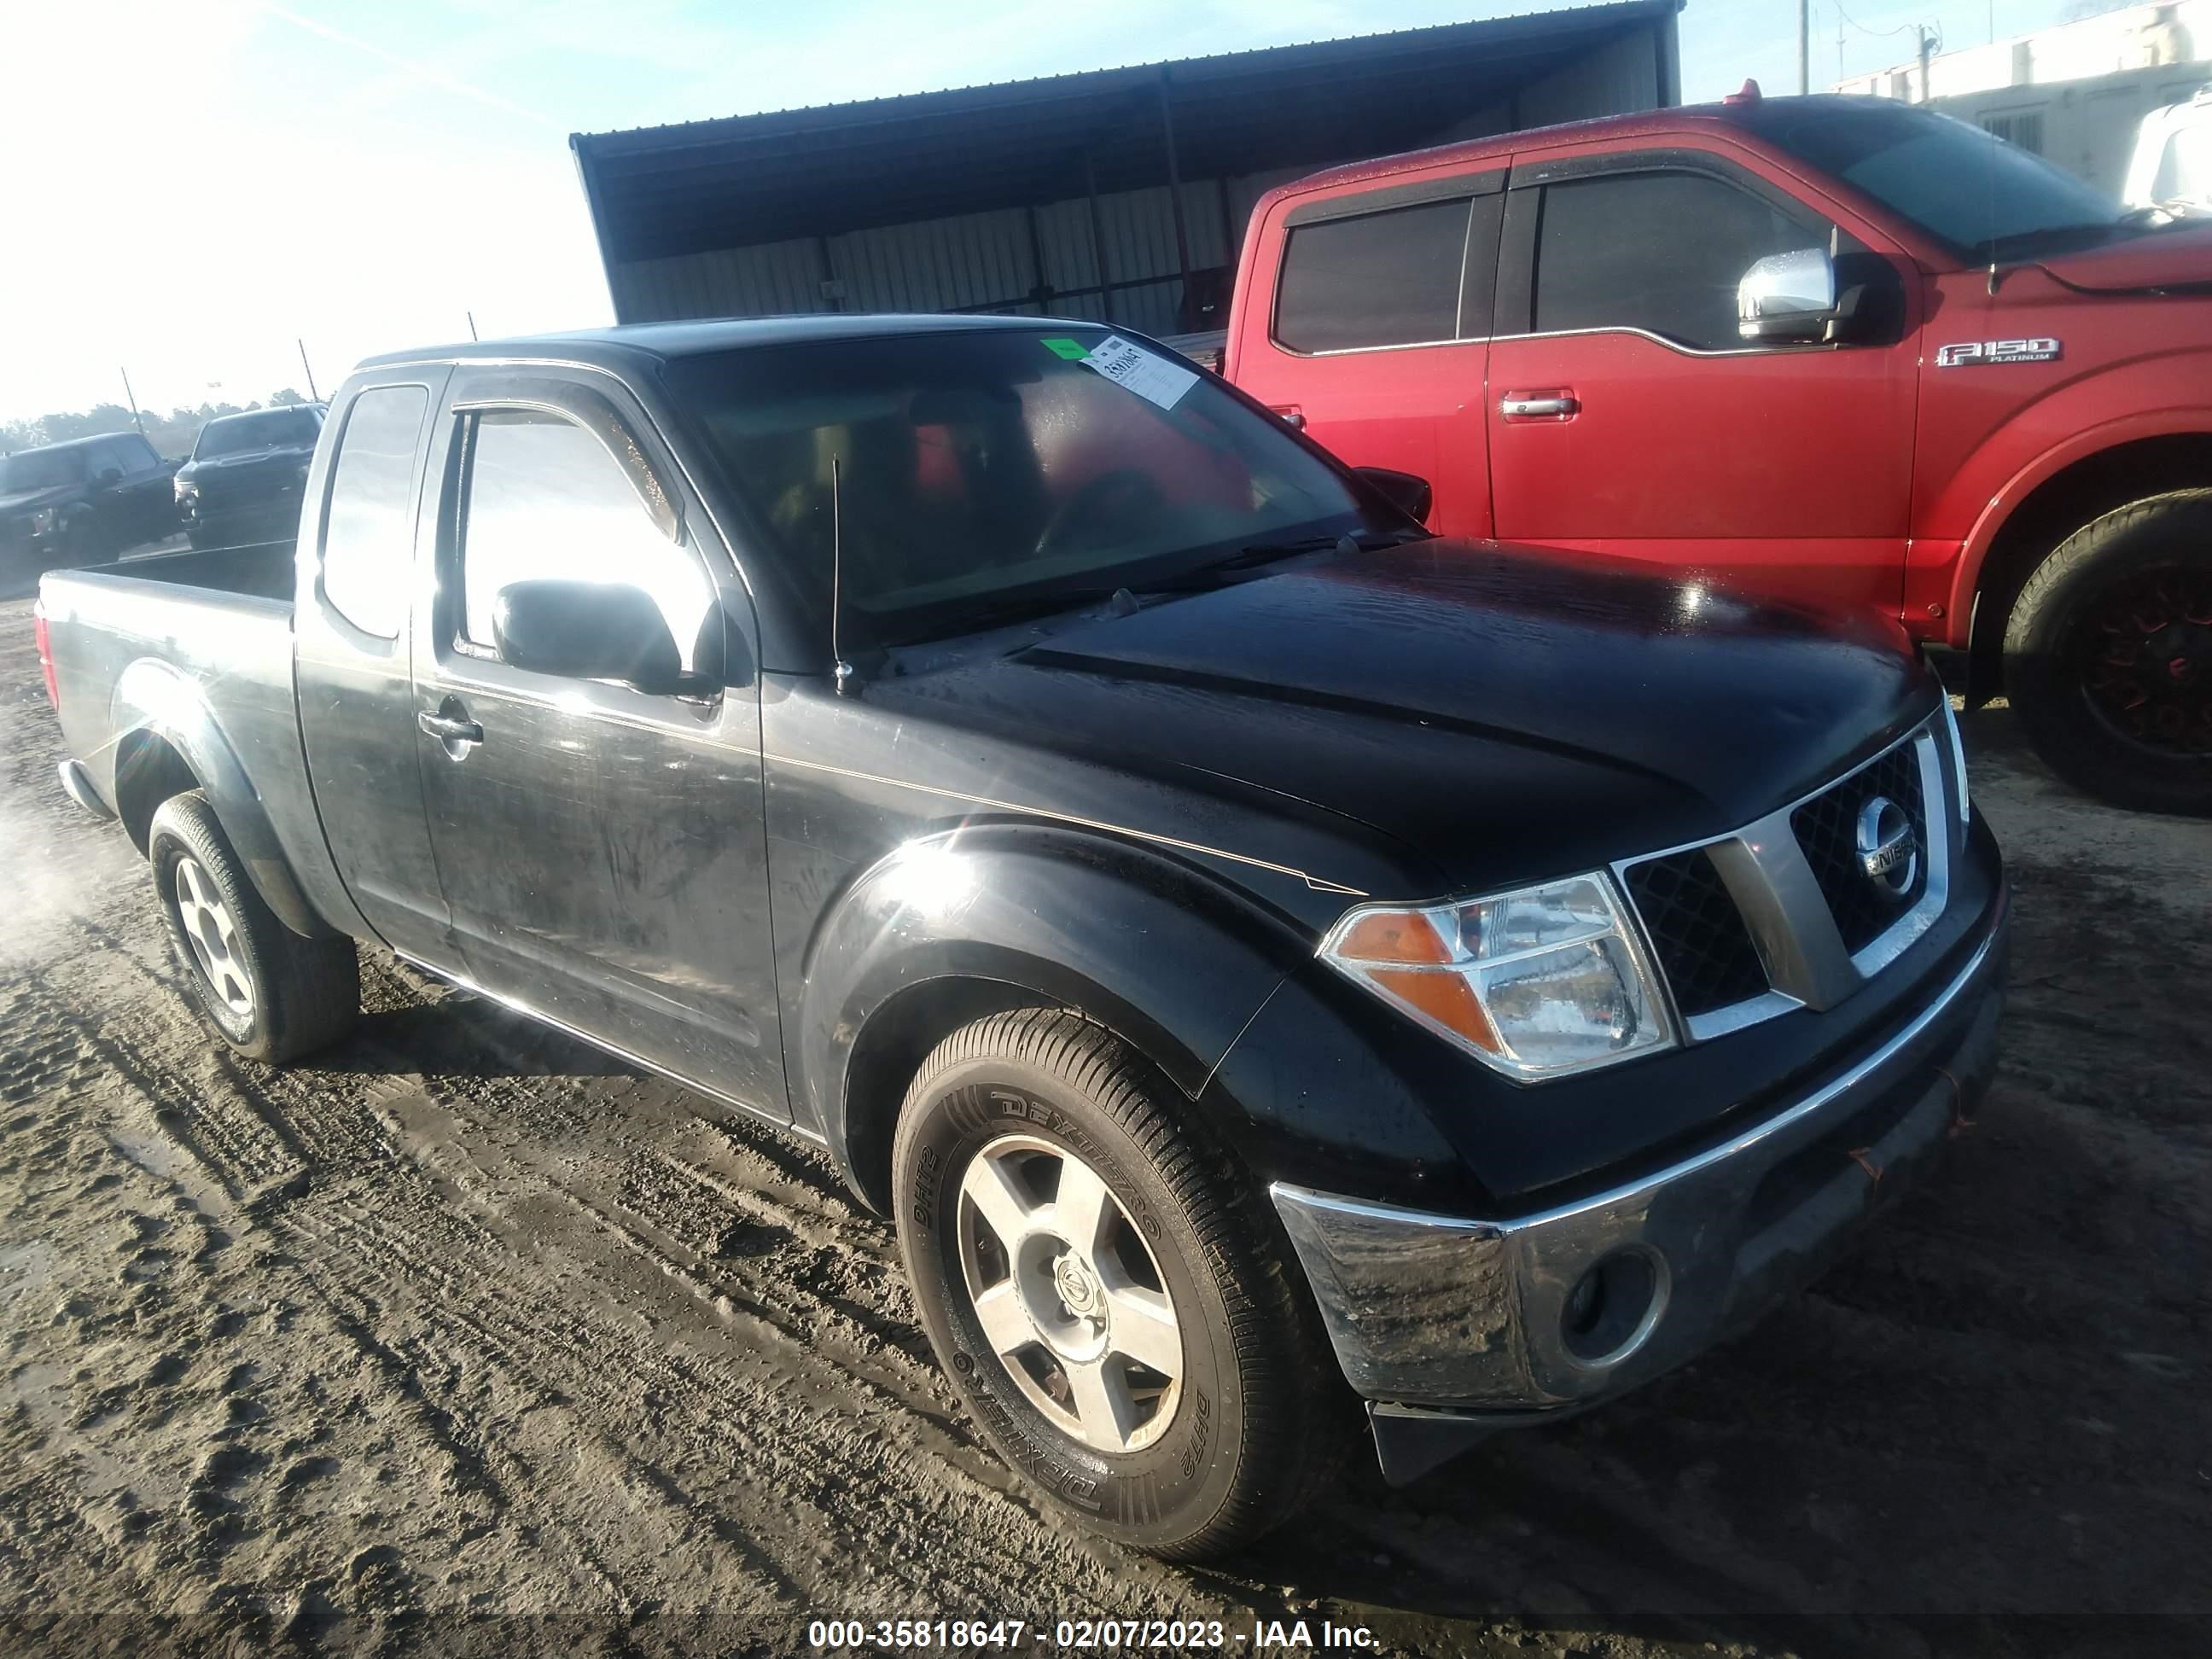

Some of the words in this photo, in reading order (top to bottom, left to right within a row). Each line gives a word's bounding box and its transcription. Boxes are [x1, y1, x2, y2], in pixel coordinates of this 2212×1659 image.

[1990, 353, 2050, 363] PLATINUM
[915, 1144, 938, 1230] DHT2
[952, 1352, 1102, 1511] DEXTERO
[1183, 1388, 1210, 1481] DHT2
